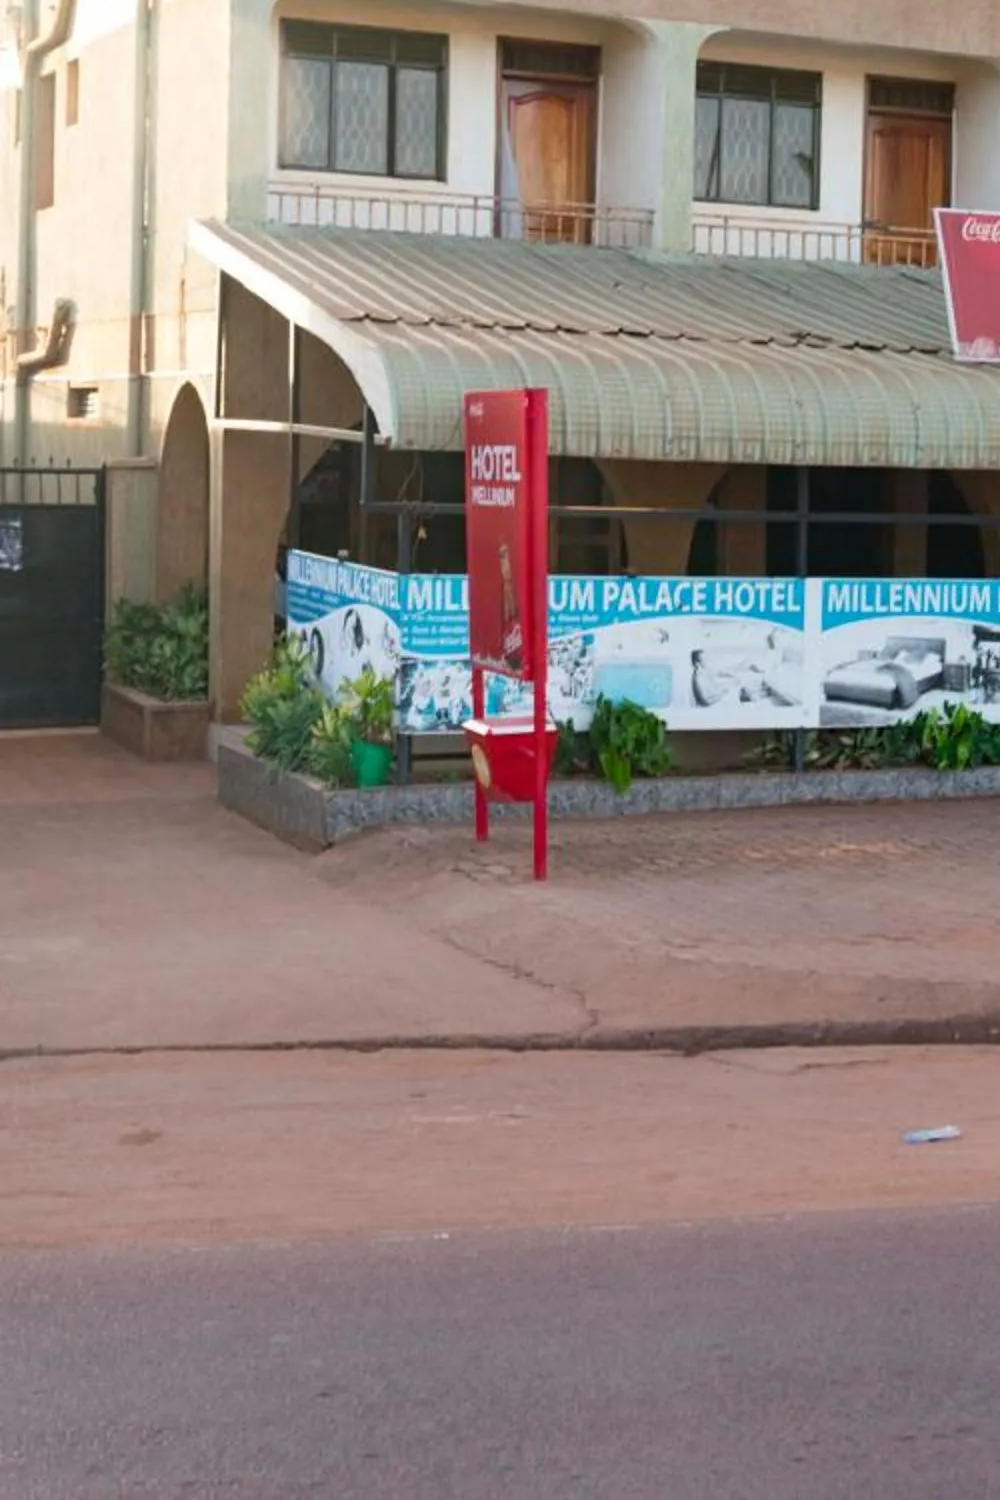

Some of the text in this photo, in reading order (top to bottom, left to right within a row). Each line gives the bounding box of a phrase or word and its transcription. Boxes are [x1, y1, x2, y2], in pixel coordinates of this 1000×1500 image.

[471, 444, 522, 482] HOTEL
[602, 581, 707, 613] PALACE
[713, 581, 801, 613] HOTEL
[826, 583, 992, 614] MILLENNIUM
